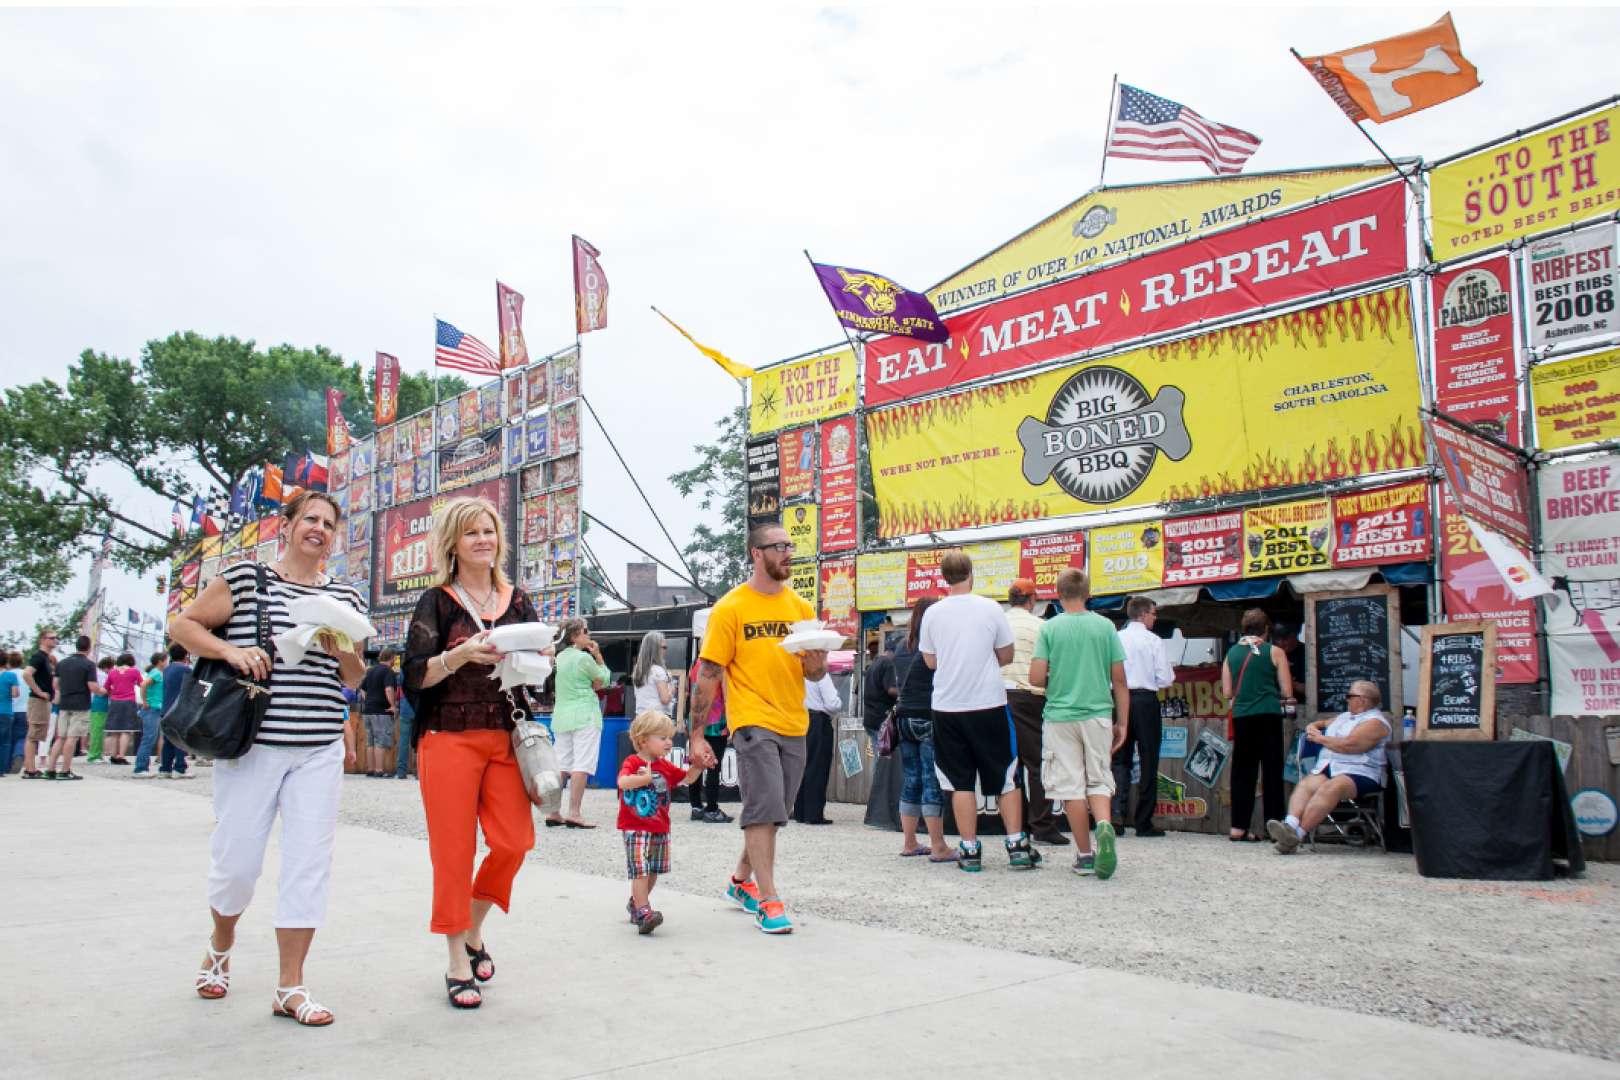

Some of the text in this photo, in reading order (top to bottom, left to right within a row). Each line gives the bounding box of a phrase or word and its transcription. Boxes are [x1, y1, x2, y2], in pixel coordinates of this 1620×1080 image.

[1548, 118, 1611, 159] THE
[1465, 153, 1598, 224] SOUTH
[1450, 188, 1620, 247] VOTED BEST BRIS
[938, 278, 996, 308] WINNER
[1003, 270, 1022, 288] OF
[1027, 258, 1067, 282] OVER
[1072, 247, 1098, 266] 100
[1103, 219, 1192, 257] NATIONAL
[1199, 188, 1282, 229] AWARDS
[1532, 246, 1613, 285] RIBFEST
[1457, 280, 1488, 304] PIGS
[1535, 274, 1613, 302] BEST RIBS
[876, 216, 1377, 384] EAT MEAT REPEAT
[1441, 294, 1508, 326] PARADISE
[1536, 289, 1615, 326] 2008
[902, 317, 934, 330] STATE
[1594, 319, 1607, 329] NC
[780, 357, 841, 384] FROM THE
[1076, 395, 1117, 418] BIG
[1274, 384, 1389, 411] SOUTH CAROLINA
[1043, 411, 1166, 456] BONED
[916, 458, 937, 471] NOT
[1077, 450, 1129, 475] BBQ
[1563, 466, 1611, 493] BEEF
[1547, 490, 1620, 520] BRISKE
[410, 515, 433, 536] CAR
[1357, 510, 1408, 531] 2011
[1029, 535, 1076, 547] NATIONAL
[1264, 526, 1307, 540] 2011
[1356, 526, 1407, 544] BEST
[1181, 537, 1224, 553] 2011
[1265, 540, 1309, 555] BEST
[1337, 539, 1426, 562] BRISKET
[1577, 538, 1609, 552] HAVE
[391, 540, 428, 577] RIB
[1104, 552, 1148, 574] 2013
[1182, 550, 1224, 567] BEST
[1248, 553, 1327, 573] SAUCE
[1567, 552, 1617, 568] EXPLAIN
[793, 576, 814, 590] 2010
[1166, 562, 1239, 583] RIBS
[396, 575, 436, 592] SPARTA
[908, 581, 932, 592] 2007
[1481, 609, 1529, 619] CHAMPION
[1496, 618, 1529, 628] AUCE
[1571, 669, 1596, 682] YOU
[1581, 684, 1595, 696] TO
